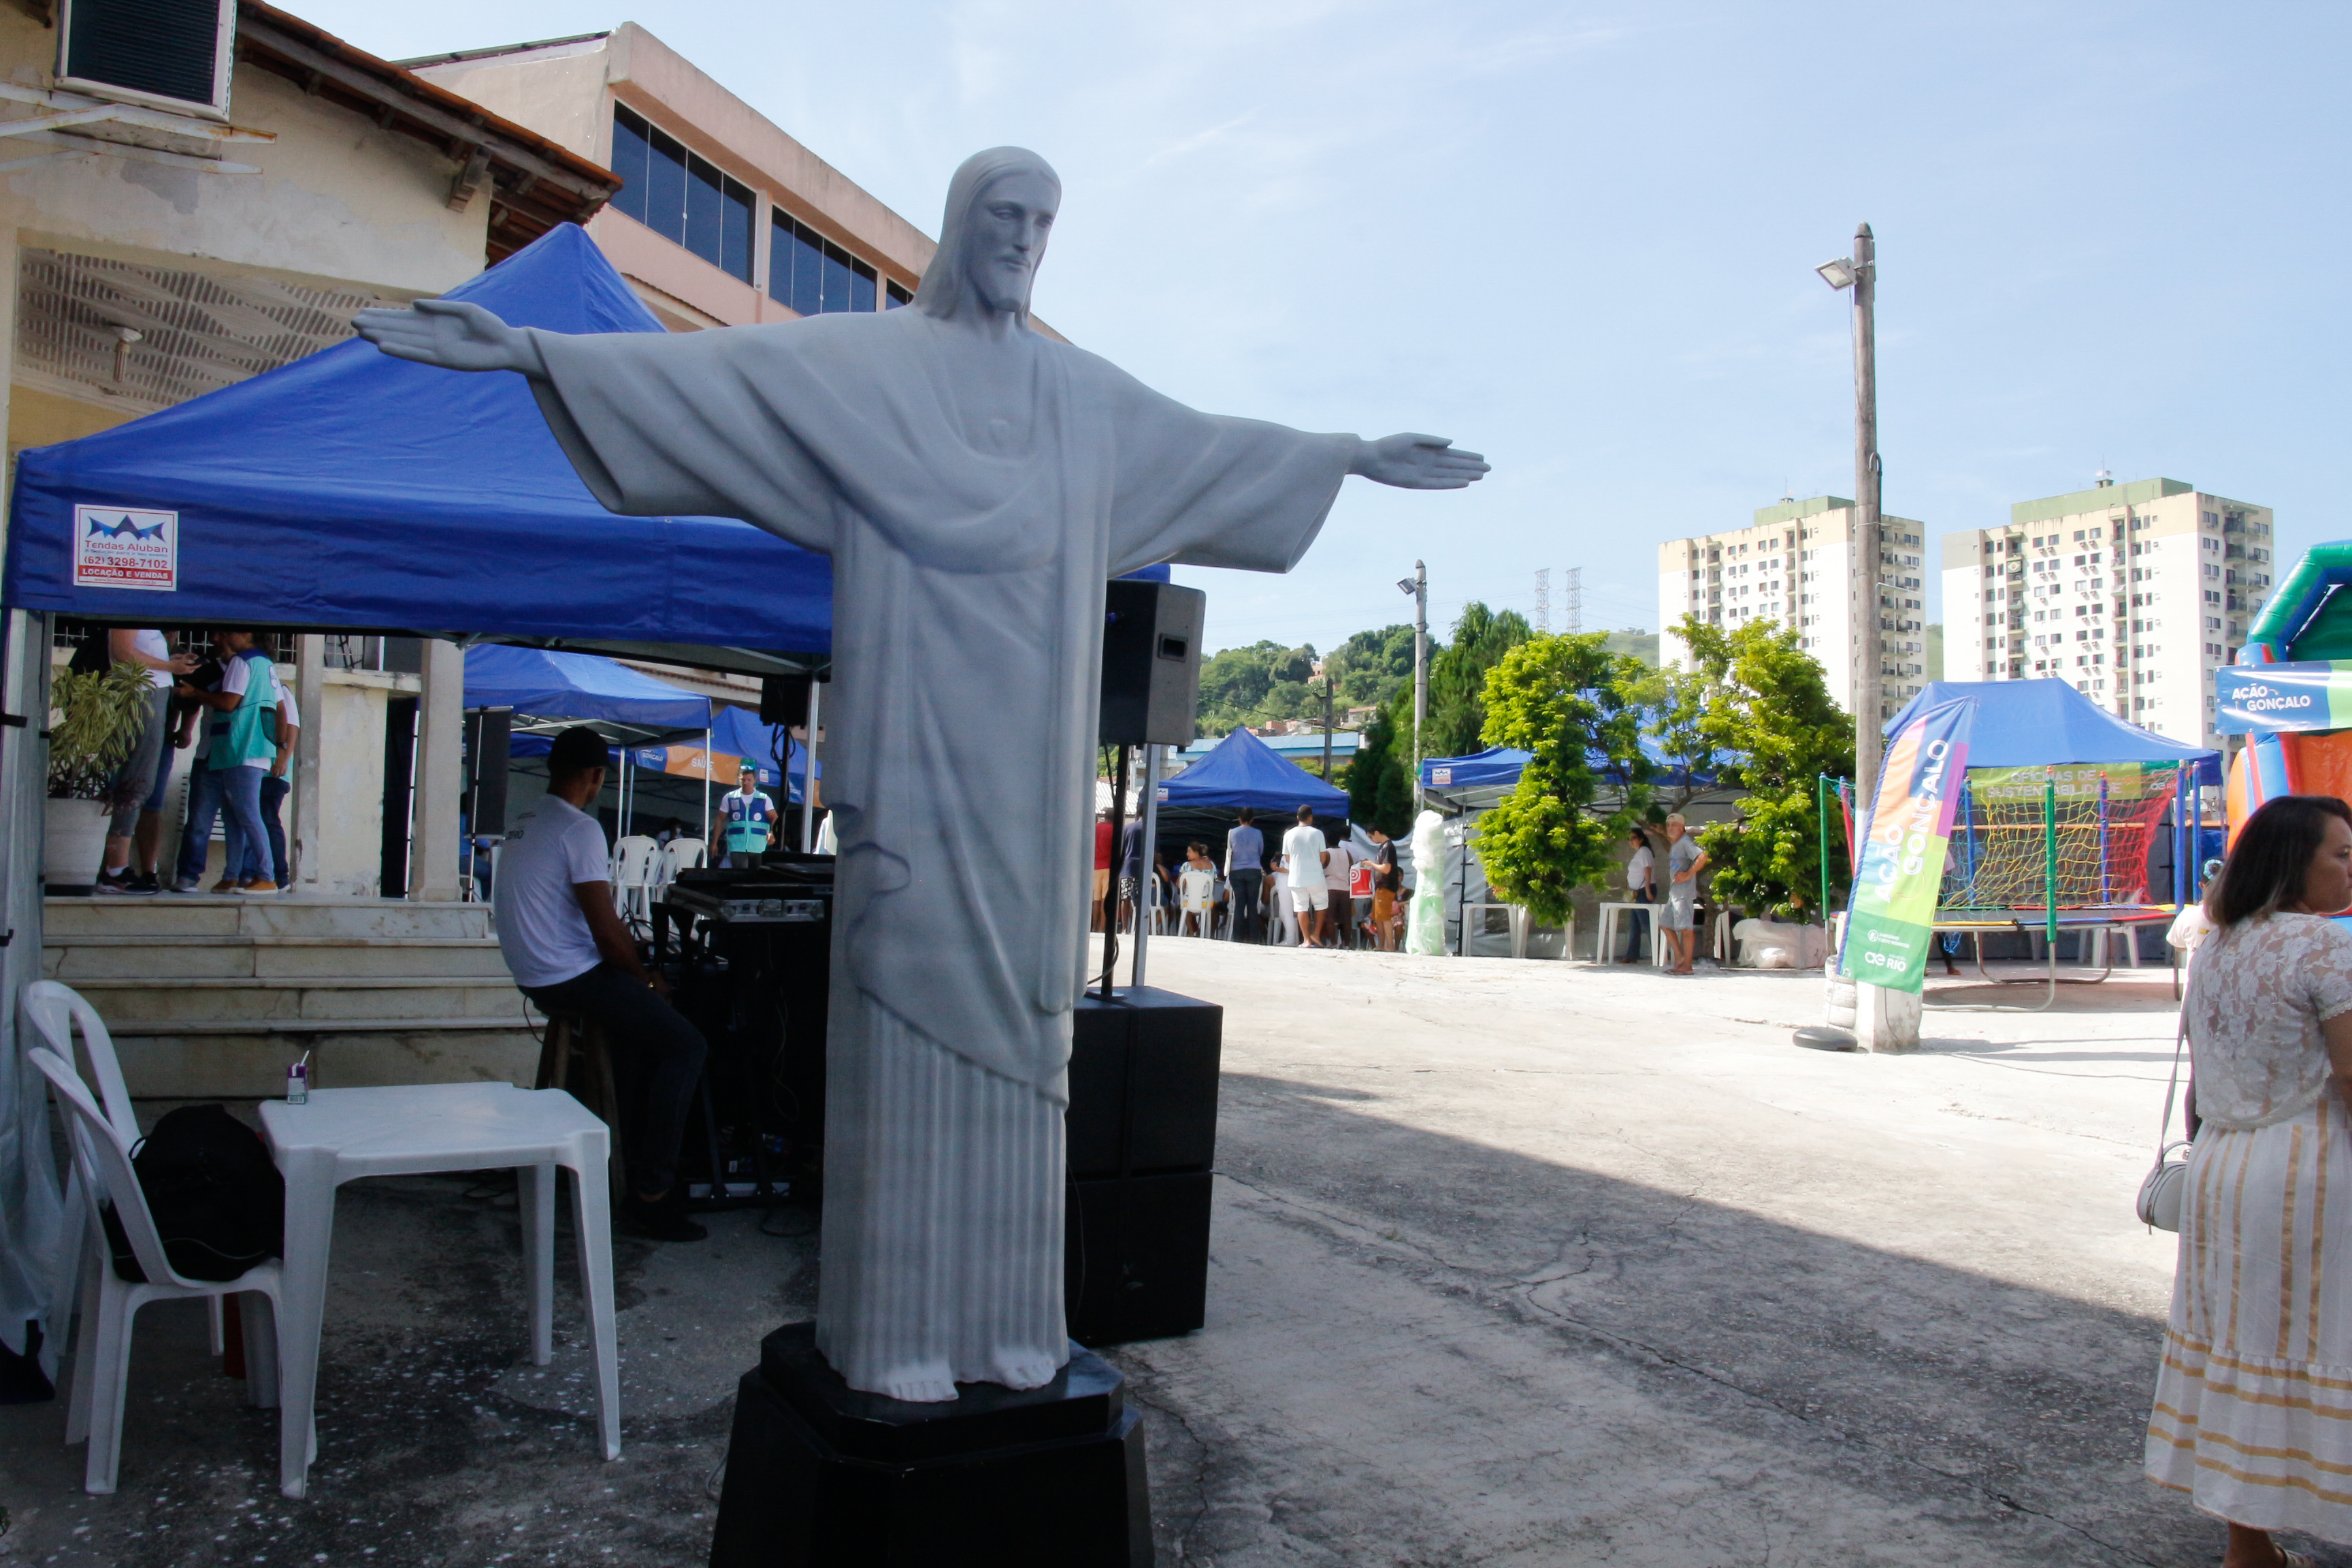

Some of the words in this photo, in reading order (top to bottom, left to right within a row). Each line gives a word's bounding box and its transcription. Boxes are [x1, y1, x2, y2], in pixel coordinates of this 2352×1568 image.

[85, 540, 125, 551] Tendas
[127, 543, 168, 553] Aluban
[84, 556, 105, 565] (62)
[108, 557, 168, 569] 3298-7102
[82, 568, 124, 578] LOCAÇÃO
[134, 572, 169, 580] VENDAS
[2232, 683, 2268, 700] AÇÃO
[2247, 695, 2310, 711] GONÇALO
[691, 755, 715, 770] SAÚE
[2078, 770, 2097, 781] DE
[1987, 783, 2123, 798] SUSTENABILIDAE
[1903, 739, 1949, 875] GONÇALO
[1875, 823, 1904, 903] AÇÃO
[1886, 958, 1906, 972] RIO
